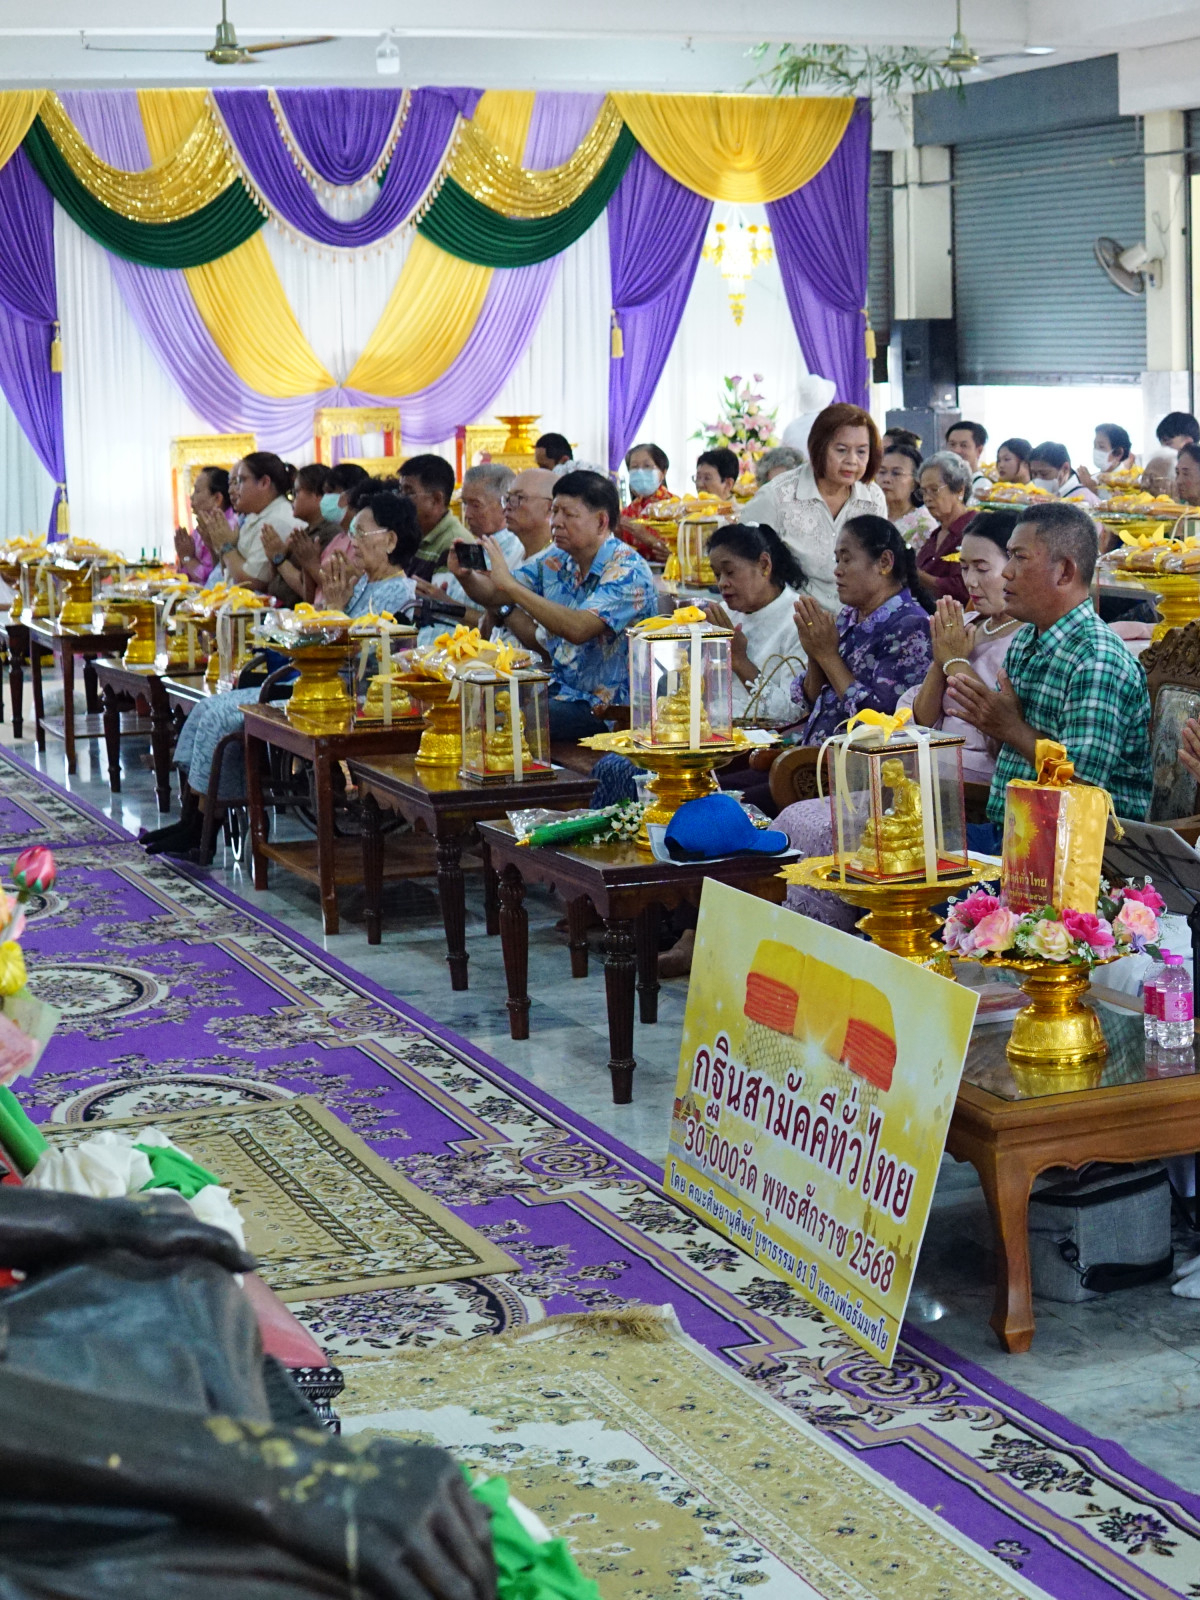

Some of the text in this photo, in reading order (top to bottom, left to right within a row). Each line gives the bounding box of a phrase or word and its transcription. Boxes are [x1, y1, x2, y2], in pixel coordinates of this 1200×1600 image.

[685, 1119, 894, 1292] 30,000วัด พุทธศักราช 2568
[694, 1036, 914, 1218] กฐินสามัคคีทั่วไทย
[669, 1162, 888, 1350] โดย คณะศิษยานุศิษย์ บูชาธรรม 81 ปี หลวงพ่อธัมมชโย
